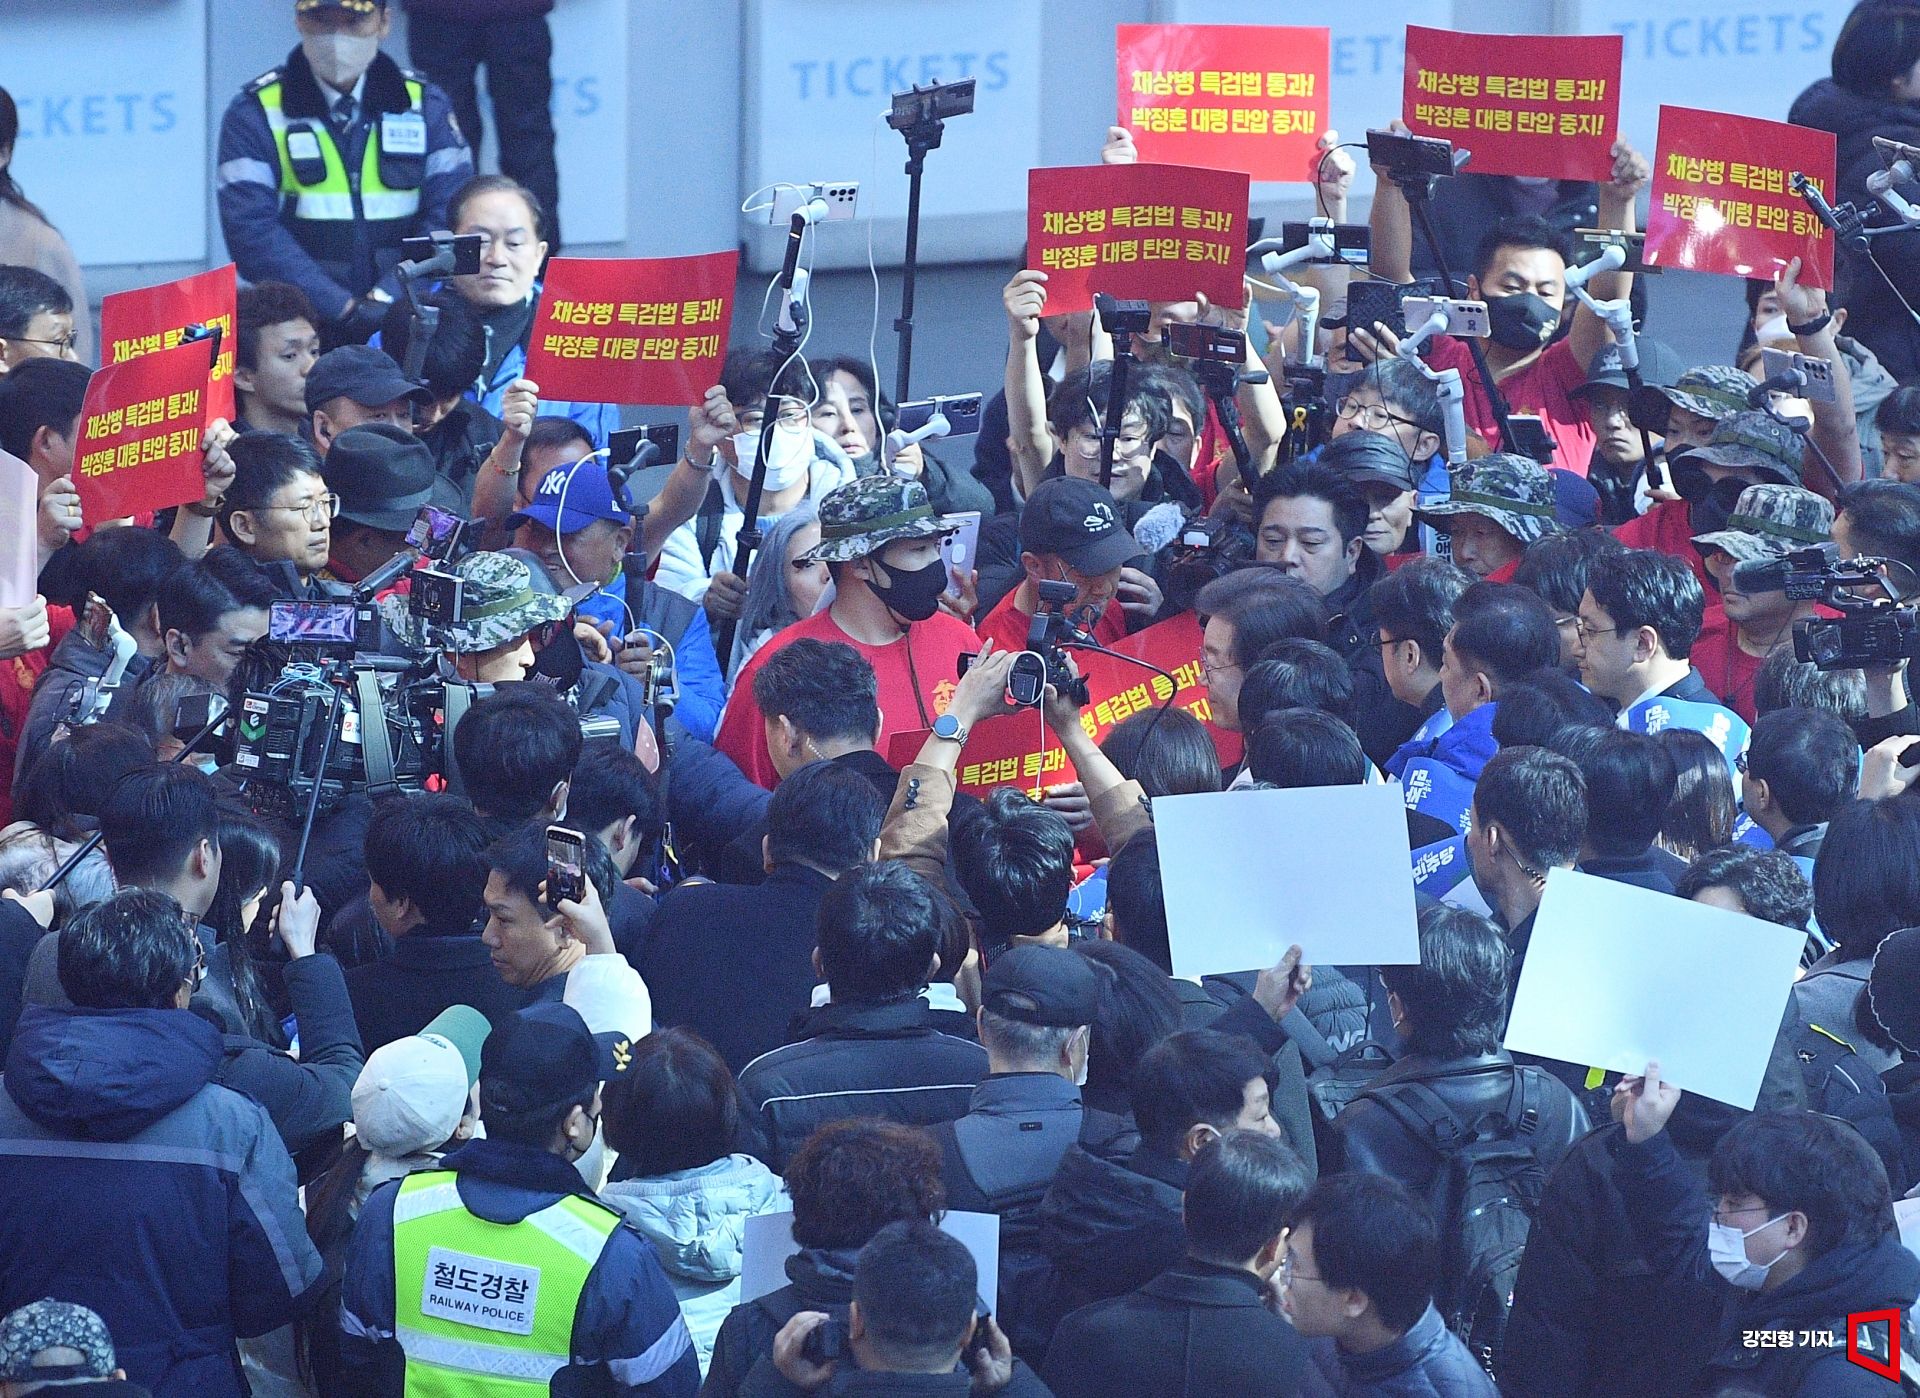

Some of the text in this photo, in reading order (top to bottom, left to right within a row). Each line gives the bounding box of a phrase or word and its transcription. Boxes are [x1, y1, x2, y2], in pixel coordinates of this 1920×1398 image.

[1610, 12, 1825, 60] TICKETS
[789, 51, 1009, 100] TICKETS
[1131, 70, 1315, 97] 채상병 특검법 통과!
[1417, 69, 1606, 102] 채상병 특검법 통과!
[1131, 107, 1316, 135] 박정훈 대령 탄압 중지!
[1415, 104, 1605, 136] 박정훈 대령 탄압 중지!
[1666, 153, 1725, 186] 채상병
[1729, 162, 1784, 194] 특검법
[1042, 204, 1233, 235] 채상병 특검법 통과!
[1719, 200, 1753, 228] 대령
[1756, 204, 1790, 232] 탄압
[1792, 211, 1824, 239] 중지!
[1042, 238, 1231, 270] 박정훈 대령 탄압 중지!
[550, 298, 723, 326] 채상병 특검법 통과!
[543, 334, 720, 361] 박정훈 대령 탄압 중지!
[85, 389, 199, 440] 채상병 특검법 통과!
[80, 428, 199, 477] 박정훈 대령 탄압 중지!
[1094, 683, 1154, 727] 특검법
[1150, 659, 1202, 701] 통과!
[962, 747, 1067, 786] 특검법 통과!
[1411, 845, 1456, 886] 민주당
[433, 1261, 530, 1305] 철도경찰
[429, 1294, 525, 1322] RAILWAY POLICE
